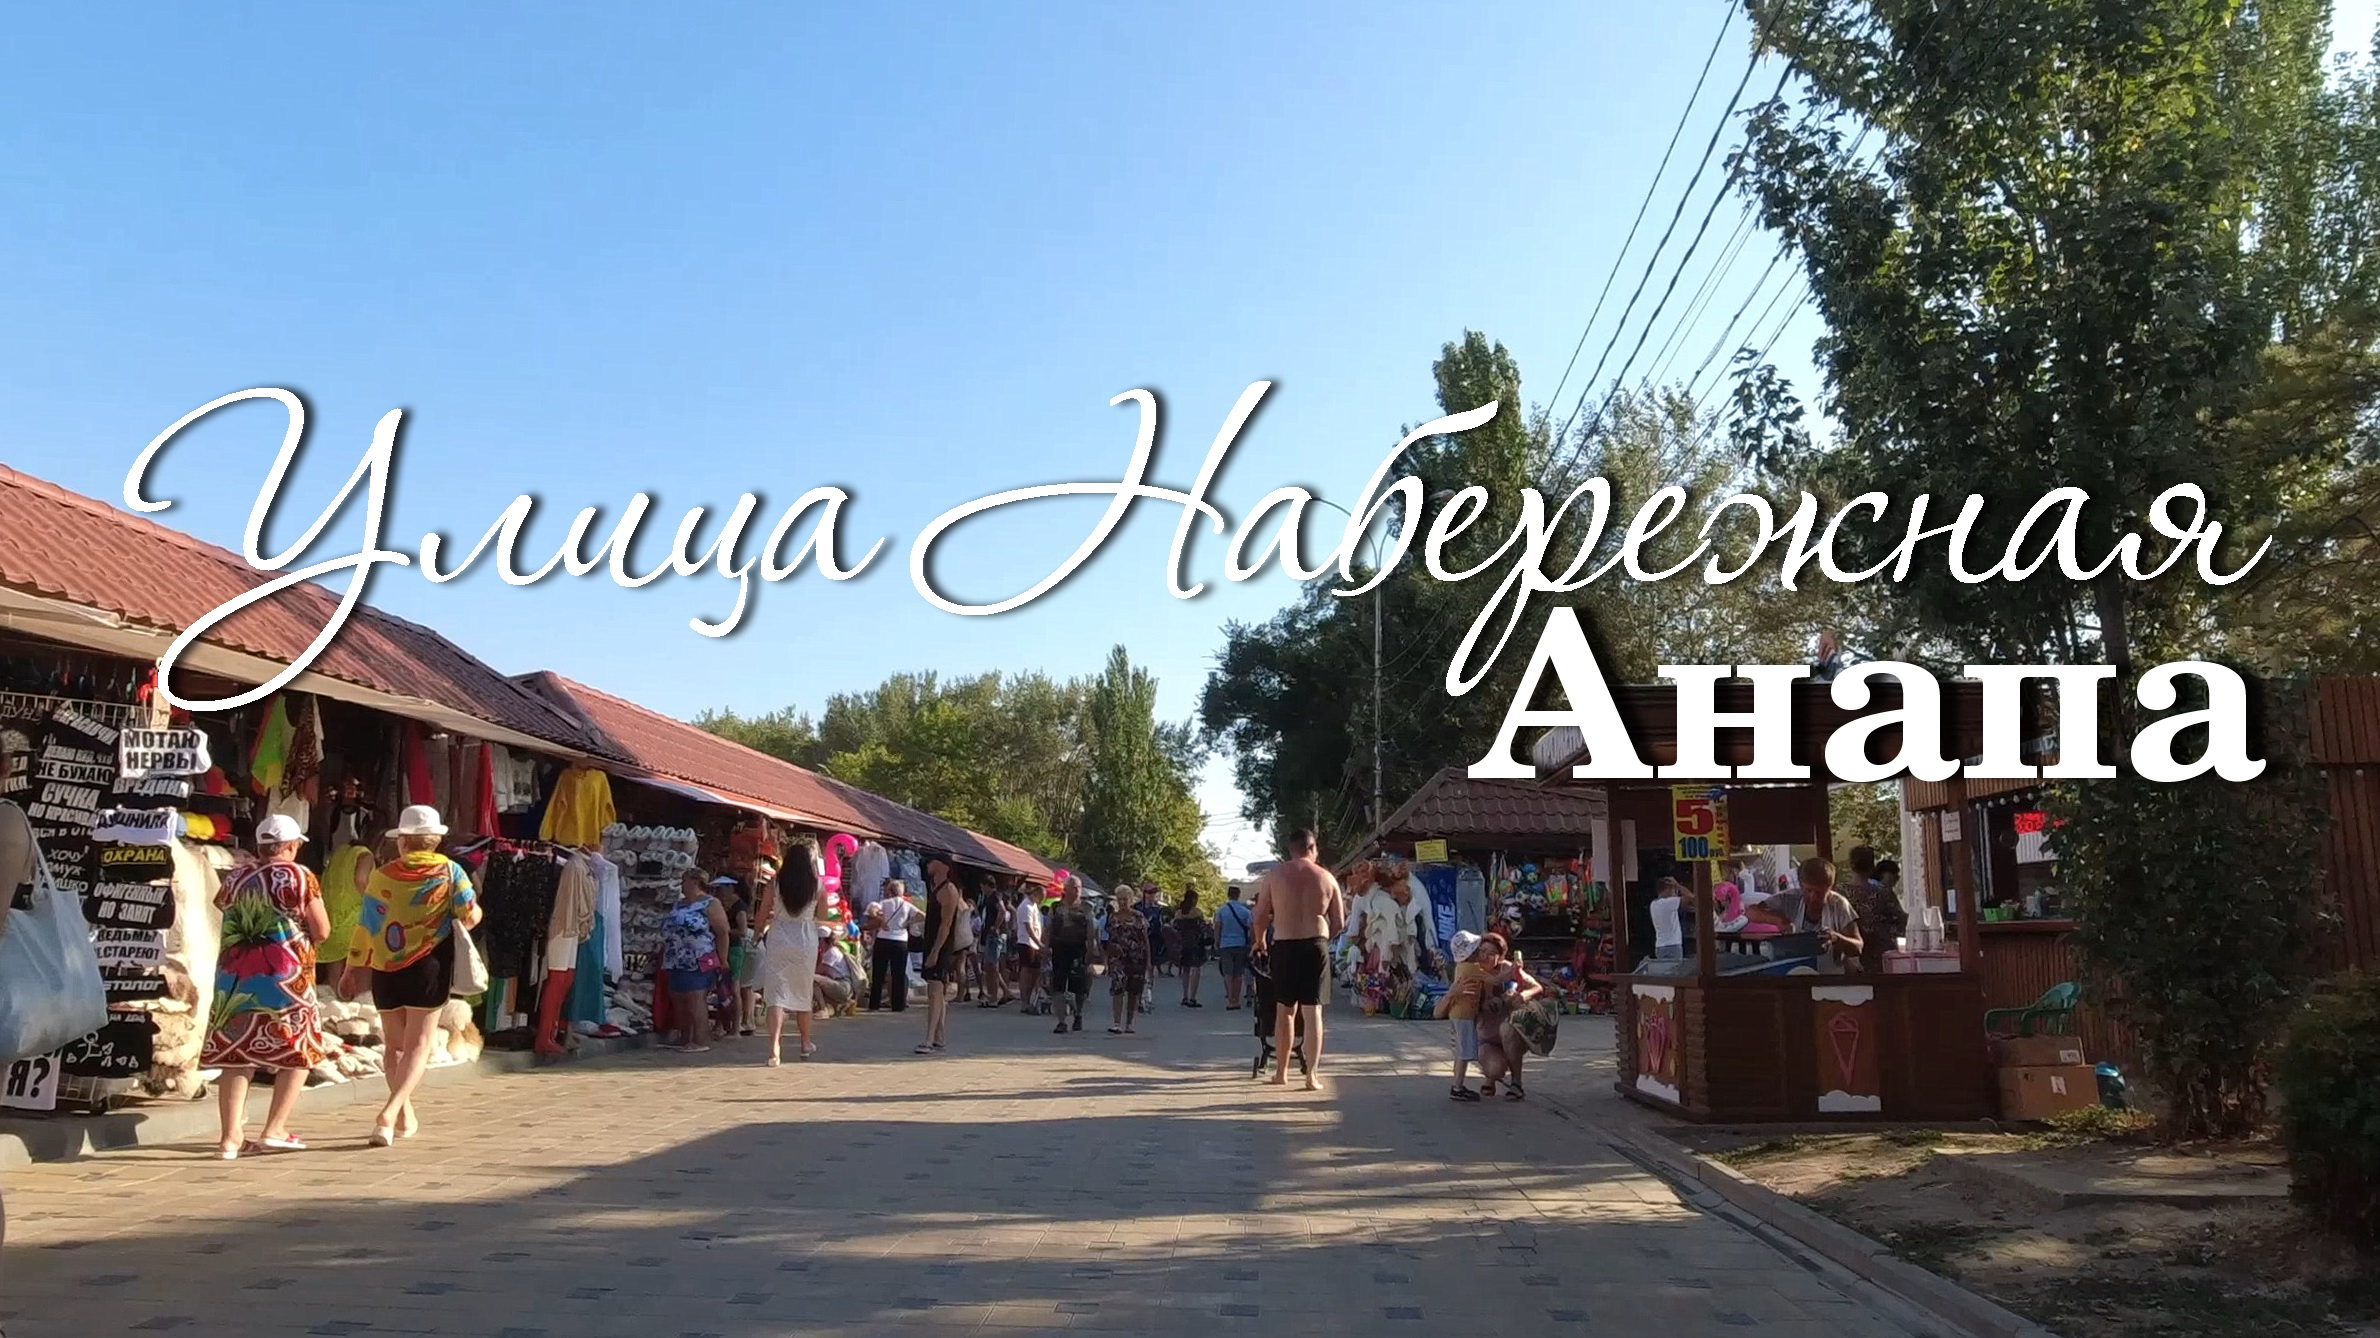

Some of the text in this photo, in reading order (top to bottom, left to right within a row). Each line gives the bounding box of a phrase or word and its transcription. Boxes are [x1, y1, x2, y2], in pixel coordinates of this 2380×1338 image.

[124, 731, 200, 748] МОТАЮ
[126, 751, 197, 770] НЕРВЫ
[58, 764, 114, 783] БУХАЮ
[41, 782, 100, 811] СУЧКА
[1676, 799, 1714, 835] 5
[104, 849, 166, 863] ОХРАНА
[1679, 836, 1709, 858] 100
[98, 900, 116, 919] НО
[1437, 903, 1456, 940] NIKE
